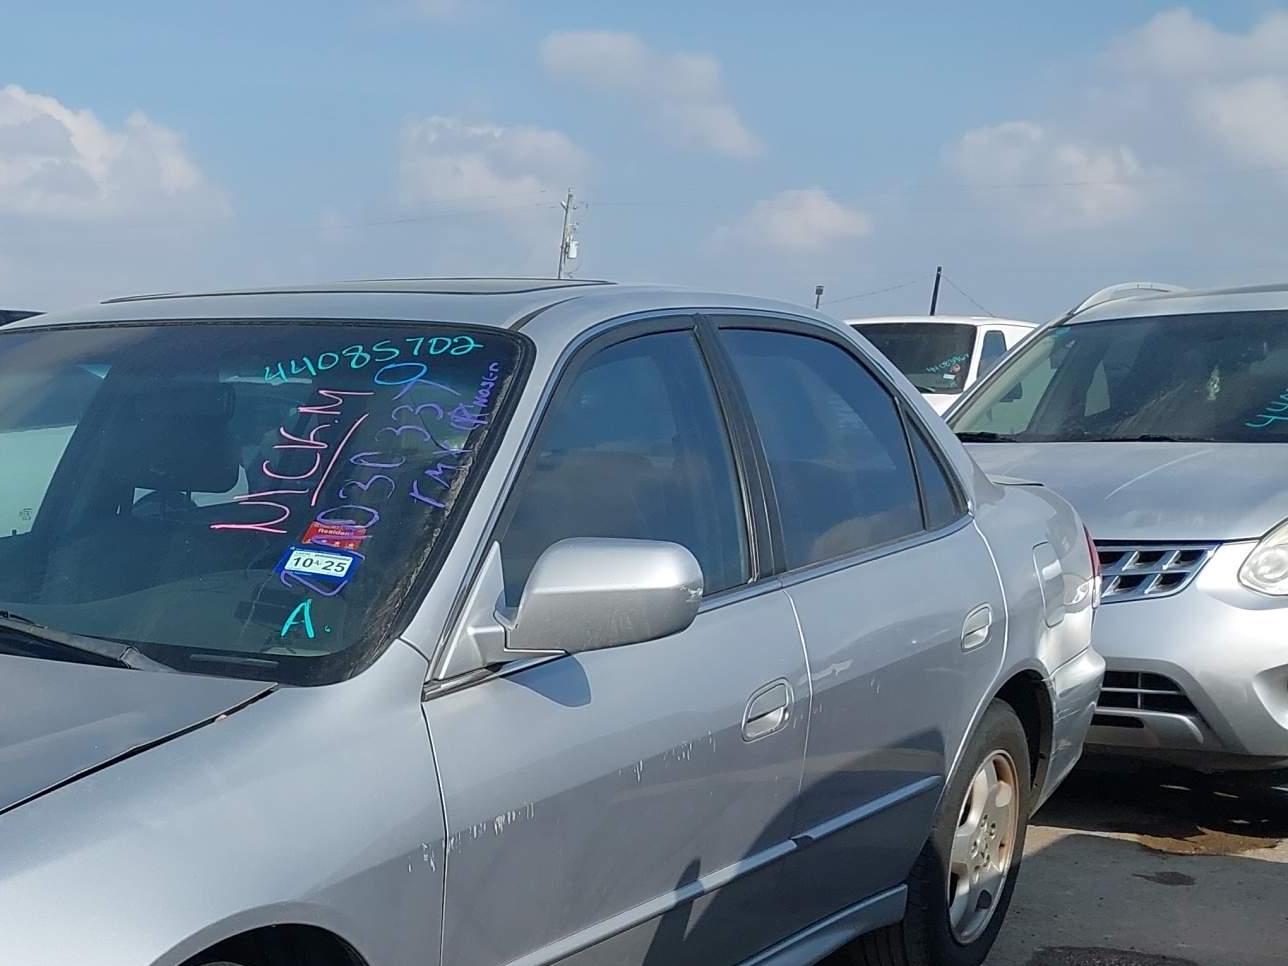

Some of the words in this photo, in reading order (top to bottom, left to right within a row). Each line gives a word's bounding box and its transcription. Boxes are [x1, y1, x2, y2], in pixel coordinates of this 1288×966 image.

[264, 335, 484, 384] 44085702
[293, 556, 314, 568] 10
[321, 560, 347, 573] 25
